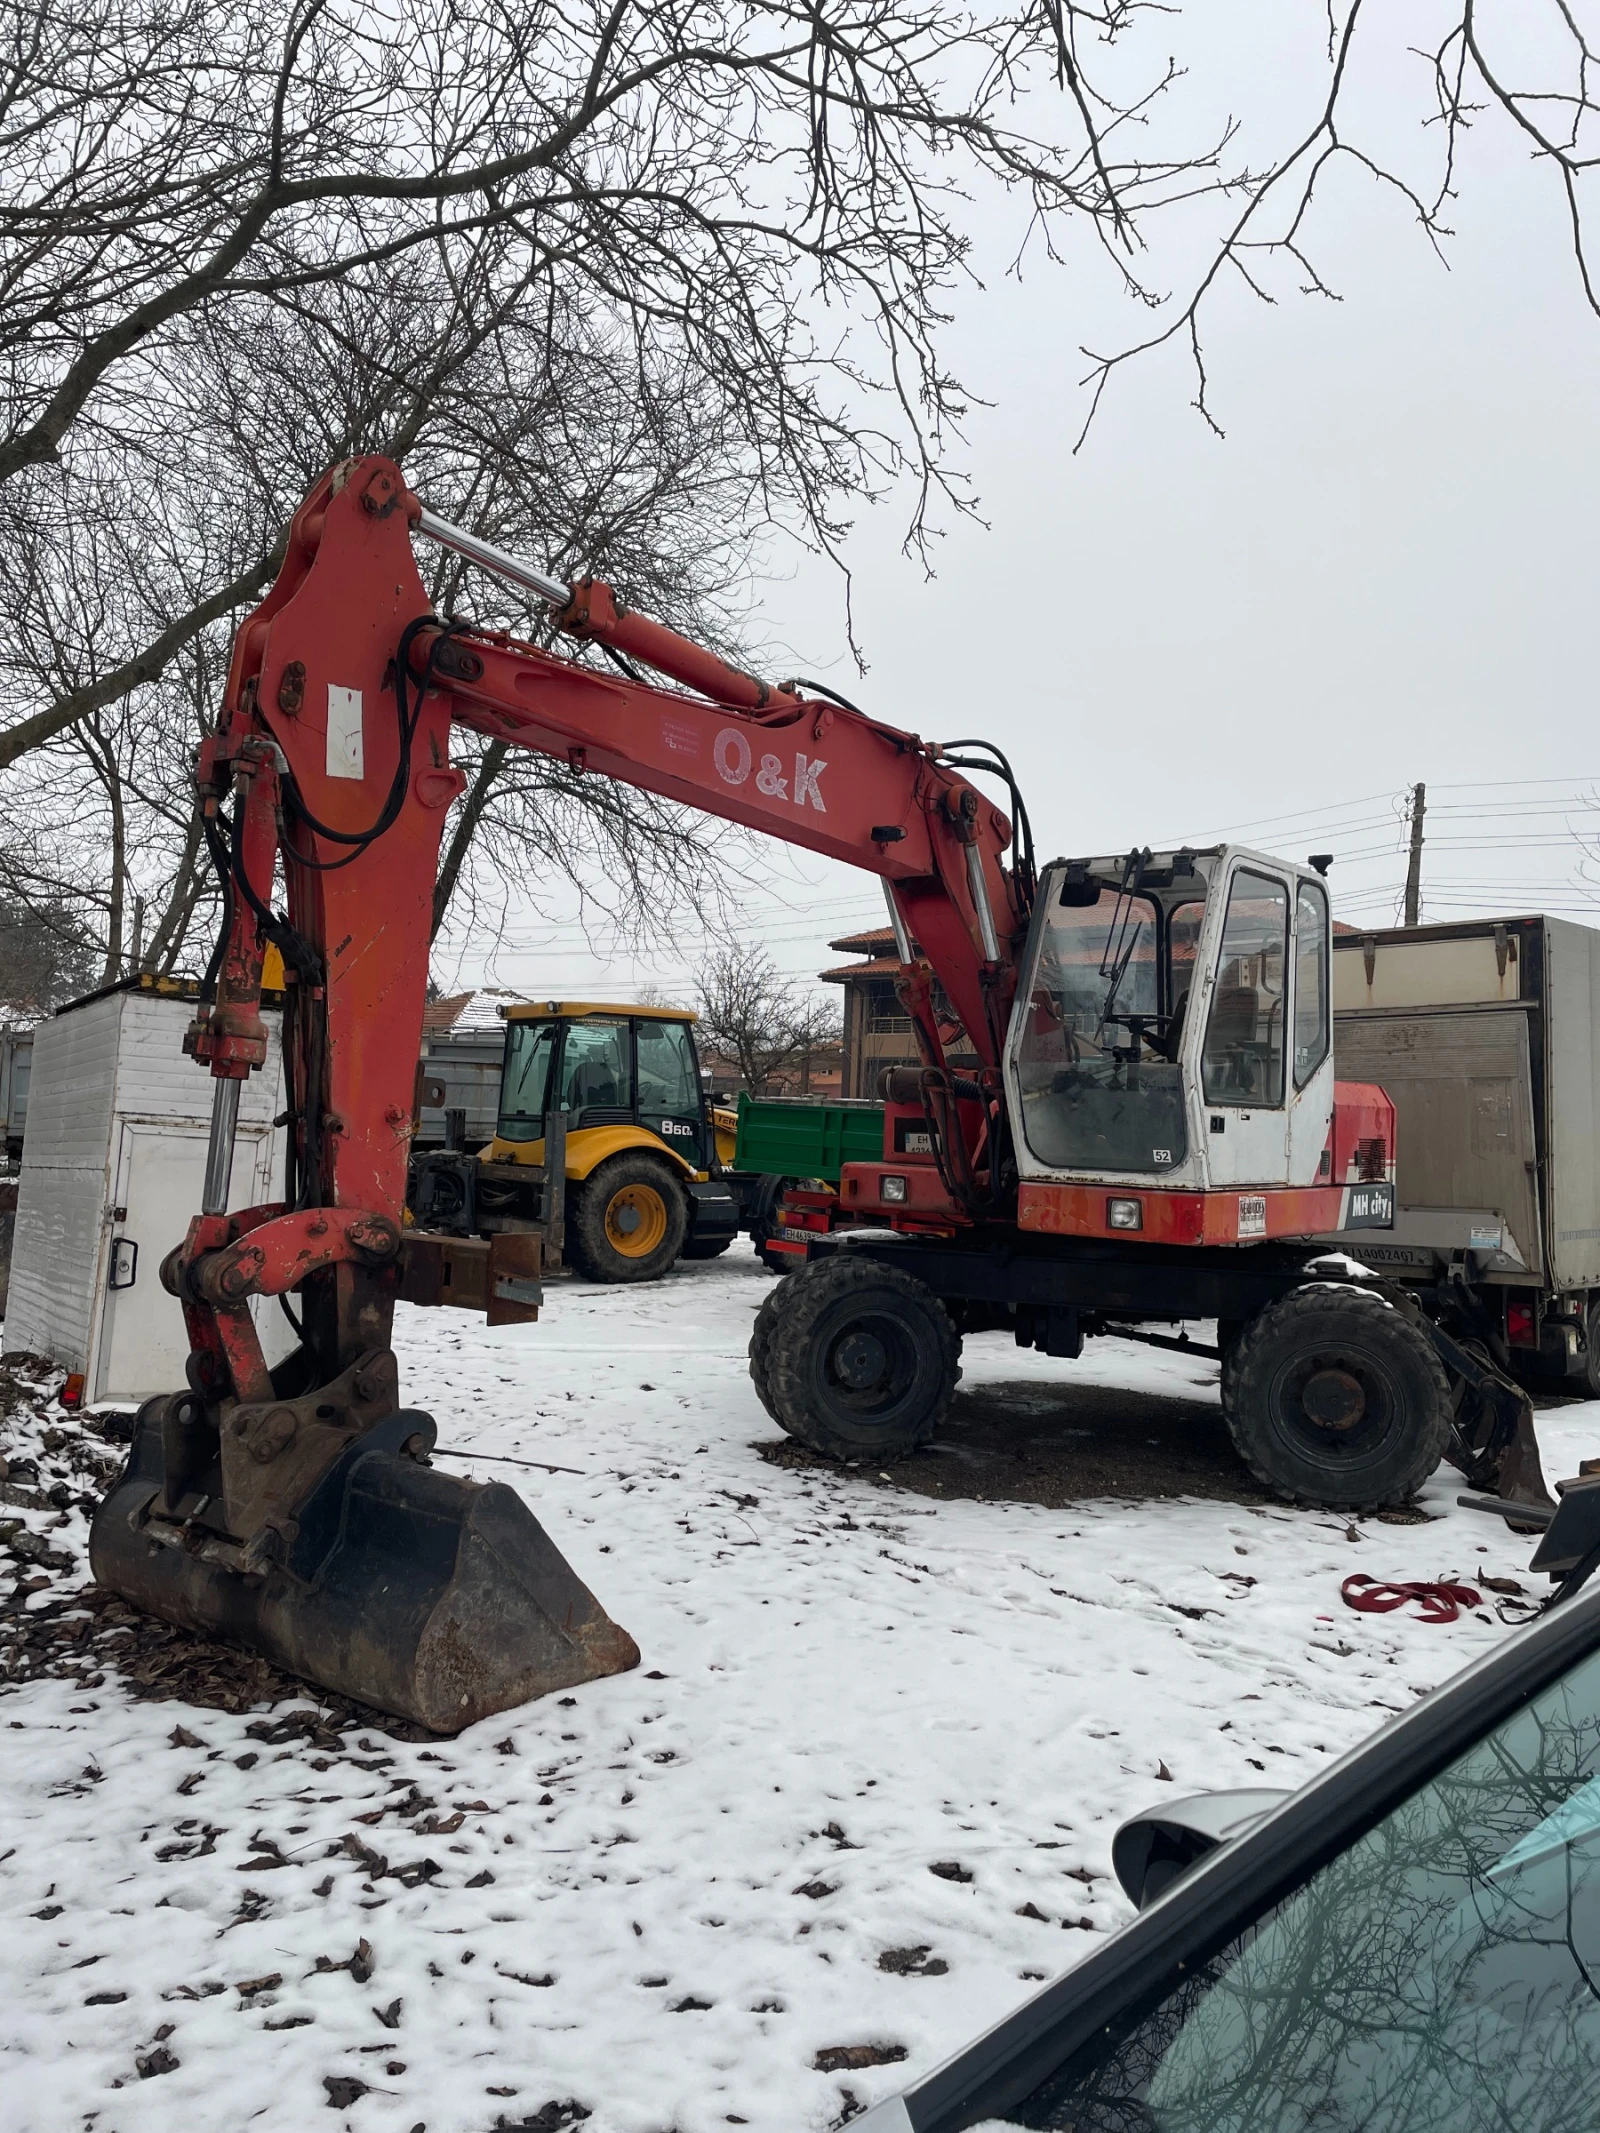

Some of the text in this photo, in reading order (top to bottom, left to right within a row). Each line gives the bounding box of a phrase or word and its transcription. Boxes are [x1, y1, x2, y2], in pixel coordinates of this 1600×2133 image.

[713, 727, 828, 813] O&K
[917, 1135, 928, 1144] EH
[1155, 1151, 1169, 1161] 52
[1352, 1191, 1388, 1219] MH city
[786, 1229, 795, 1240] EH
